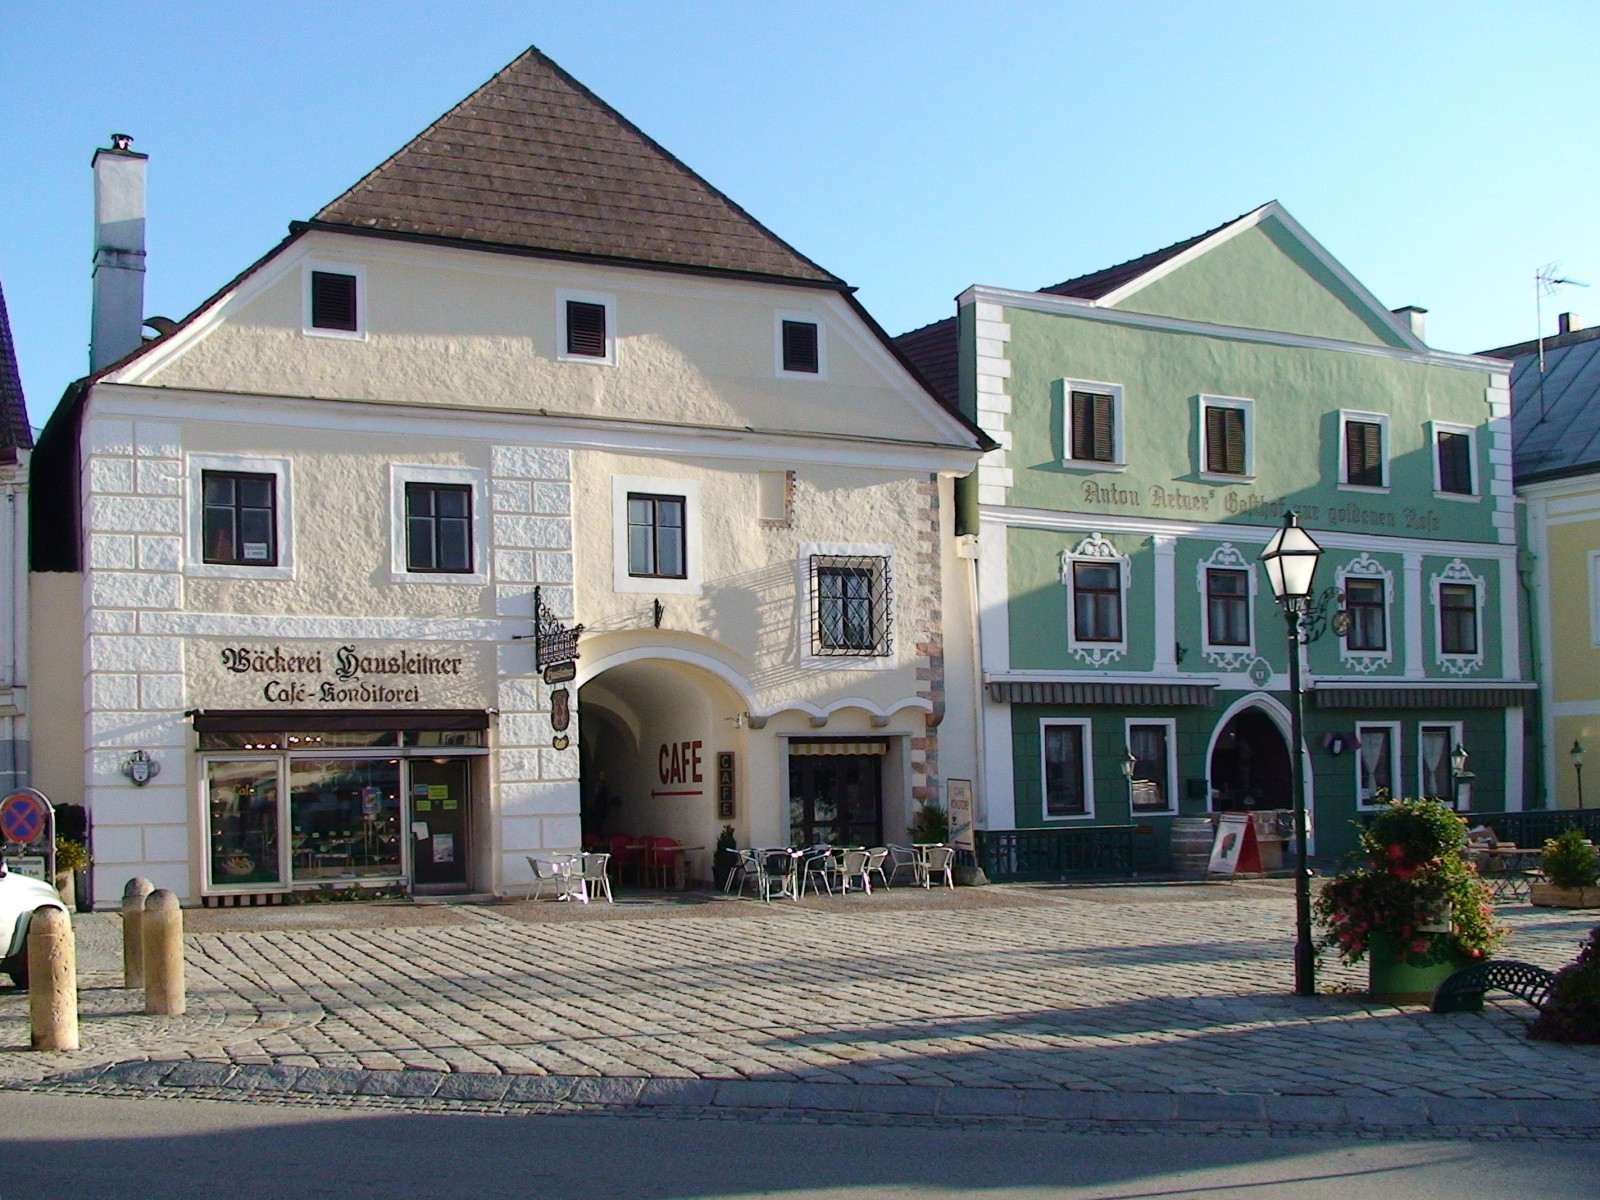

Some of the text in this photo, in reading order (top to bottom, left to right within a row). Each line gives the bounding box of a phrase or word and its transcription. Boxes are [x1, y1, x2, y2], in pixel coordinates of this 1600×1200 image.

[1081, 479, 1140, 506] Anton
[1328, 503, 1396, 526] goldenen
[222, 645, 462, 682] Bäckerei Hausleitner
[659, 740, 703, 785] CAFE
[720, 755, 733, 816] CAFE
